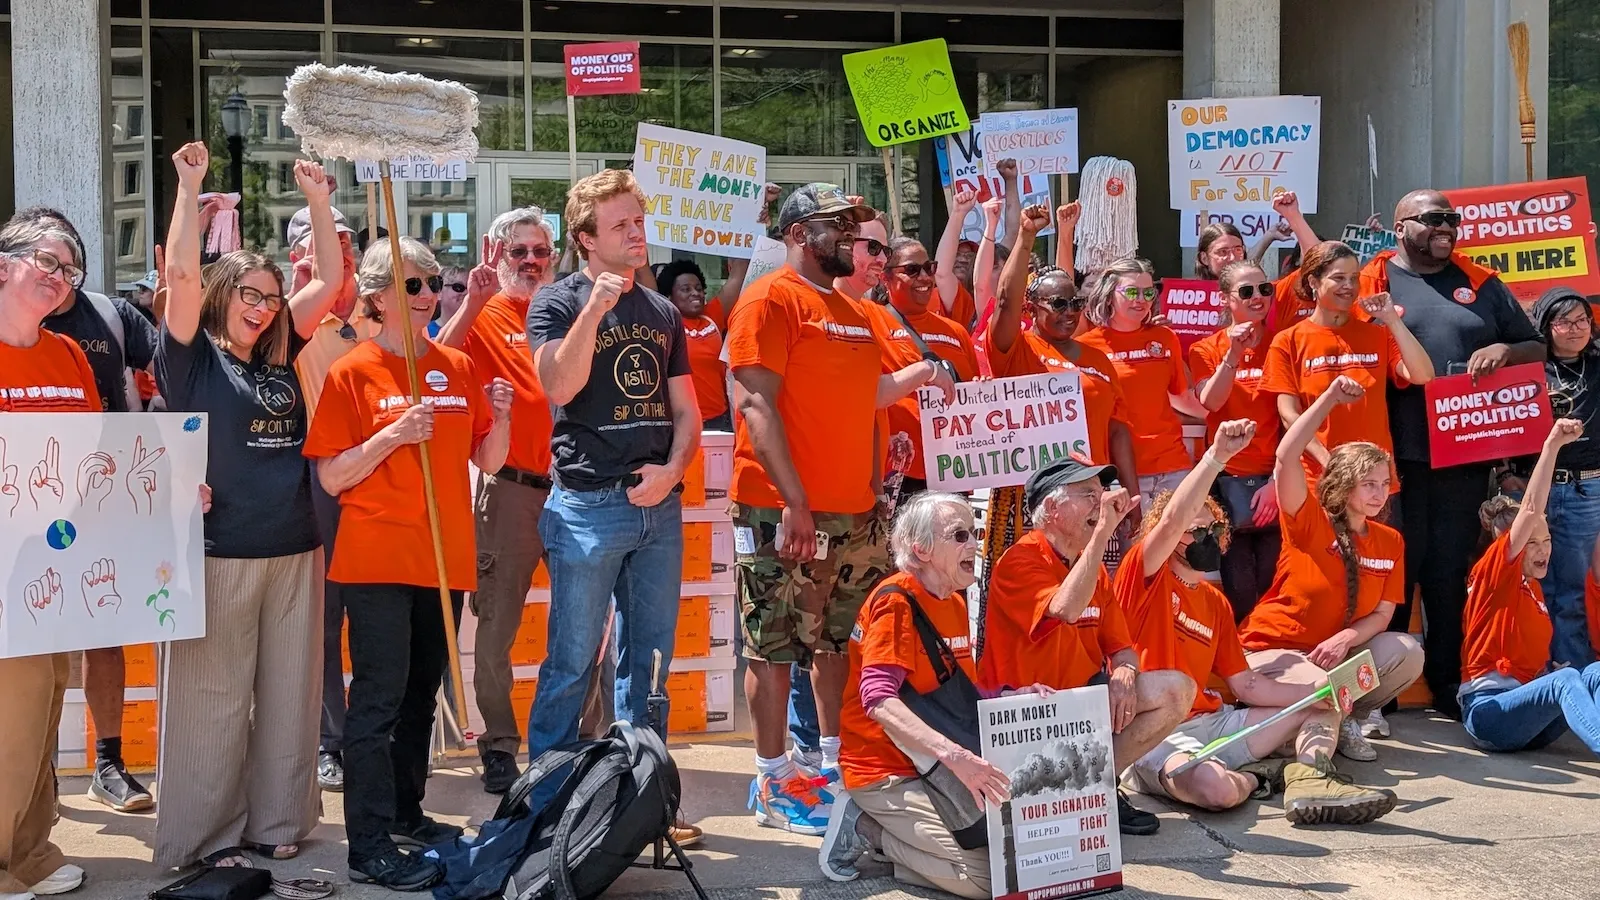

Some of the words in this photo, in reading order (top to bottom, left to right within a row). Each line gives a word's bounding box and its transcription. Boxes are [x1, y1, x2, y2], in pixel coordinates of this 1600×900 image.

[571, 54, 610, 65] MONEY
[610, 53, 633, 63] OUT
[571, 66, 586, 75] OF
[587, 64, 633, 75] POLITICS
[878, 111, 960, 141] ORGANIZE
[1181, 105, 1228, 126] OUR
[985, 129, 1067, 153] NOSOTROS
[1186, 124, 1312, 153] DEMOCRACY
[640, 138, 702, 167] THEY
[710, 151, 757, 176] HAVE
[986, 155, 1071, 178] PDER
[1189, 156, 1202, 170] is
[1218, 150, 1294, 171] NOT
[363, 166, 374, 179] IN
[415, 164, 461, 180] PEOPLE
[956, 165, 977, 177] are
[657, 166, 696, 189] THE
[698, 172, 762, 200] MONEY
[1190, 180, 1227, 201] For
[645, 194, 672, 215] WE
[681, 197, 733, 223] HAVE
[1454, 200, 1522, 221] MONEY
[1524, 195, 1570, 214] OUT
[654, 220, 688, 243] THE
[693, 226, 753, 248] POWER
[1345, 226, 1371, 240] THE
[1478, 214, 1573, 239] POLITICS
[1516, 246, 1576, 272] HERE
[1167, 289, 1206, 305] MOP
[1210, 290, 1224, 307] U
[80, 340, 110, 354] OCIAL
[594, 324, 630, 354] DISTILL
[631, 323, 667, 350] SOCIAL
[26, 386, 41, 398] UP
[957, 385, 997, 406] United
[1003, 379, 1046, 401] Health
[1435, 390, 1494, 414] MONEY
[1497, 383, 1537, 404] OUT
[613, 405, 630, 420] SIP
[932, 413, 976, 439] PAY
[985, 399, 1078, 432] CLAIMS
[1437, 415, 1458, 431] OF
[1461, 403, 1541, 429] POLITICS
[955, 434, 996, 450] instead
[1001, 431, 1016, 444] of
[1455, 426, 1524, 442] MopUpMichigan.org
[936, 439, 1087, 482] POLITICIANS
[990, 708, 1017, 726] DARK
[1021, 703, 1057, 721] MONEY
[991, 727, 1042, 748] POLLUTES
[1046, 720, 1096, 740] POLITICS.
[1021, 803, 1048, 821] YOUR
[1052, 793, 1106, 816] SIGNATURE
[1027, 826, 1060, 839] HELPED
[1080, 814, 1108, 831] FIGHT
[1080, 835, 1109, 853] BACK.
[1020, 857, 1043, 868] Thank
[1044, 850, 1070, 864] YOU!!!
[1027, 879, 1095, 900] MOPUPMICHIGAN.ORG
